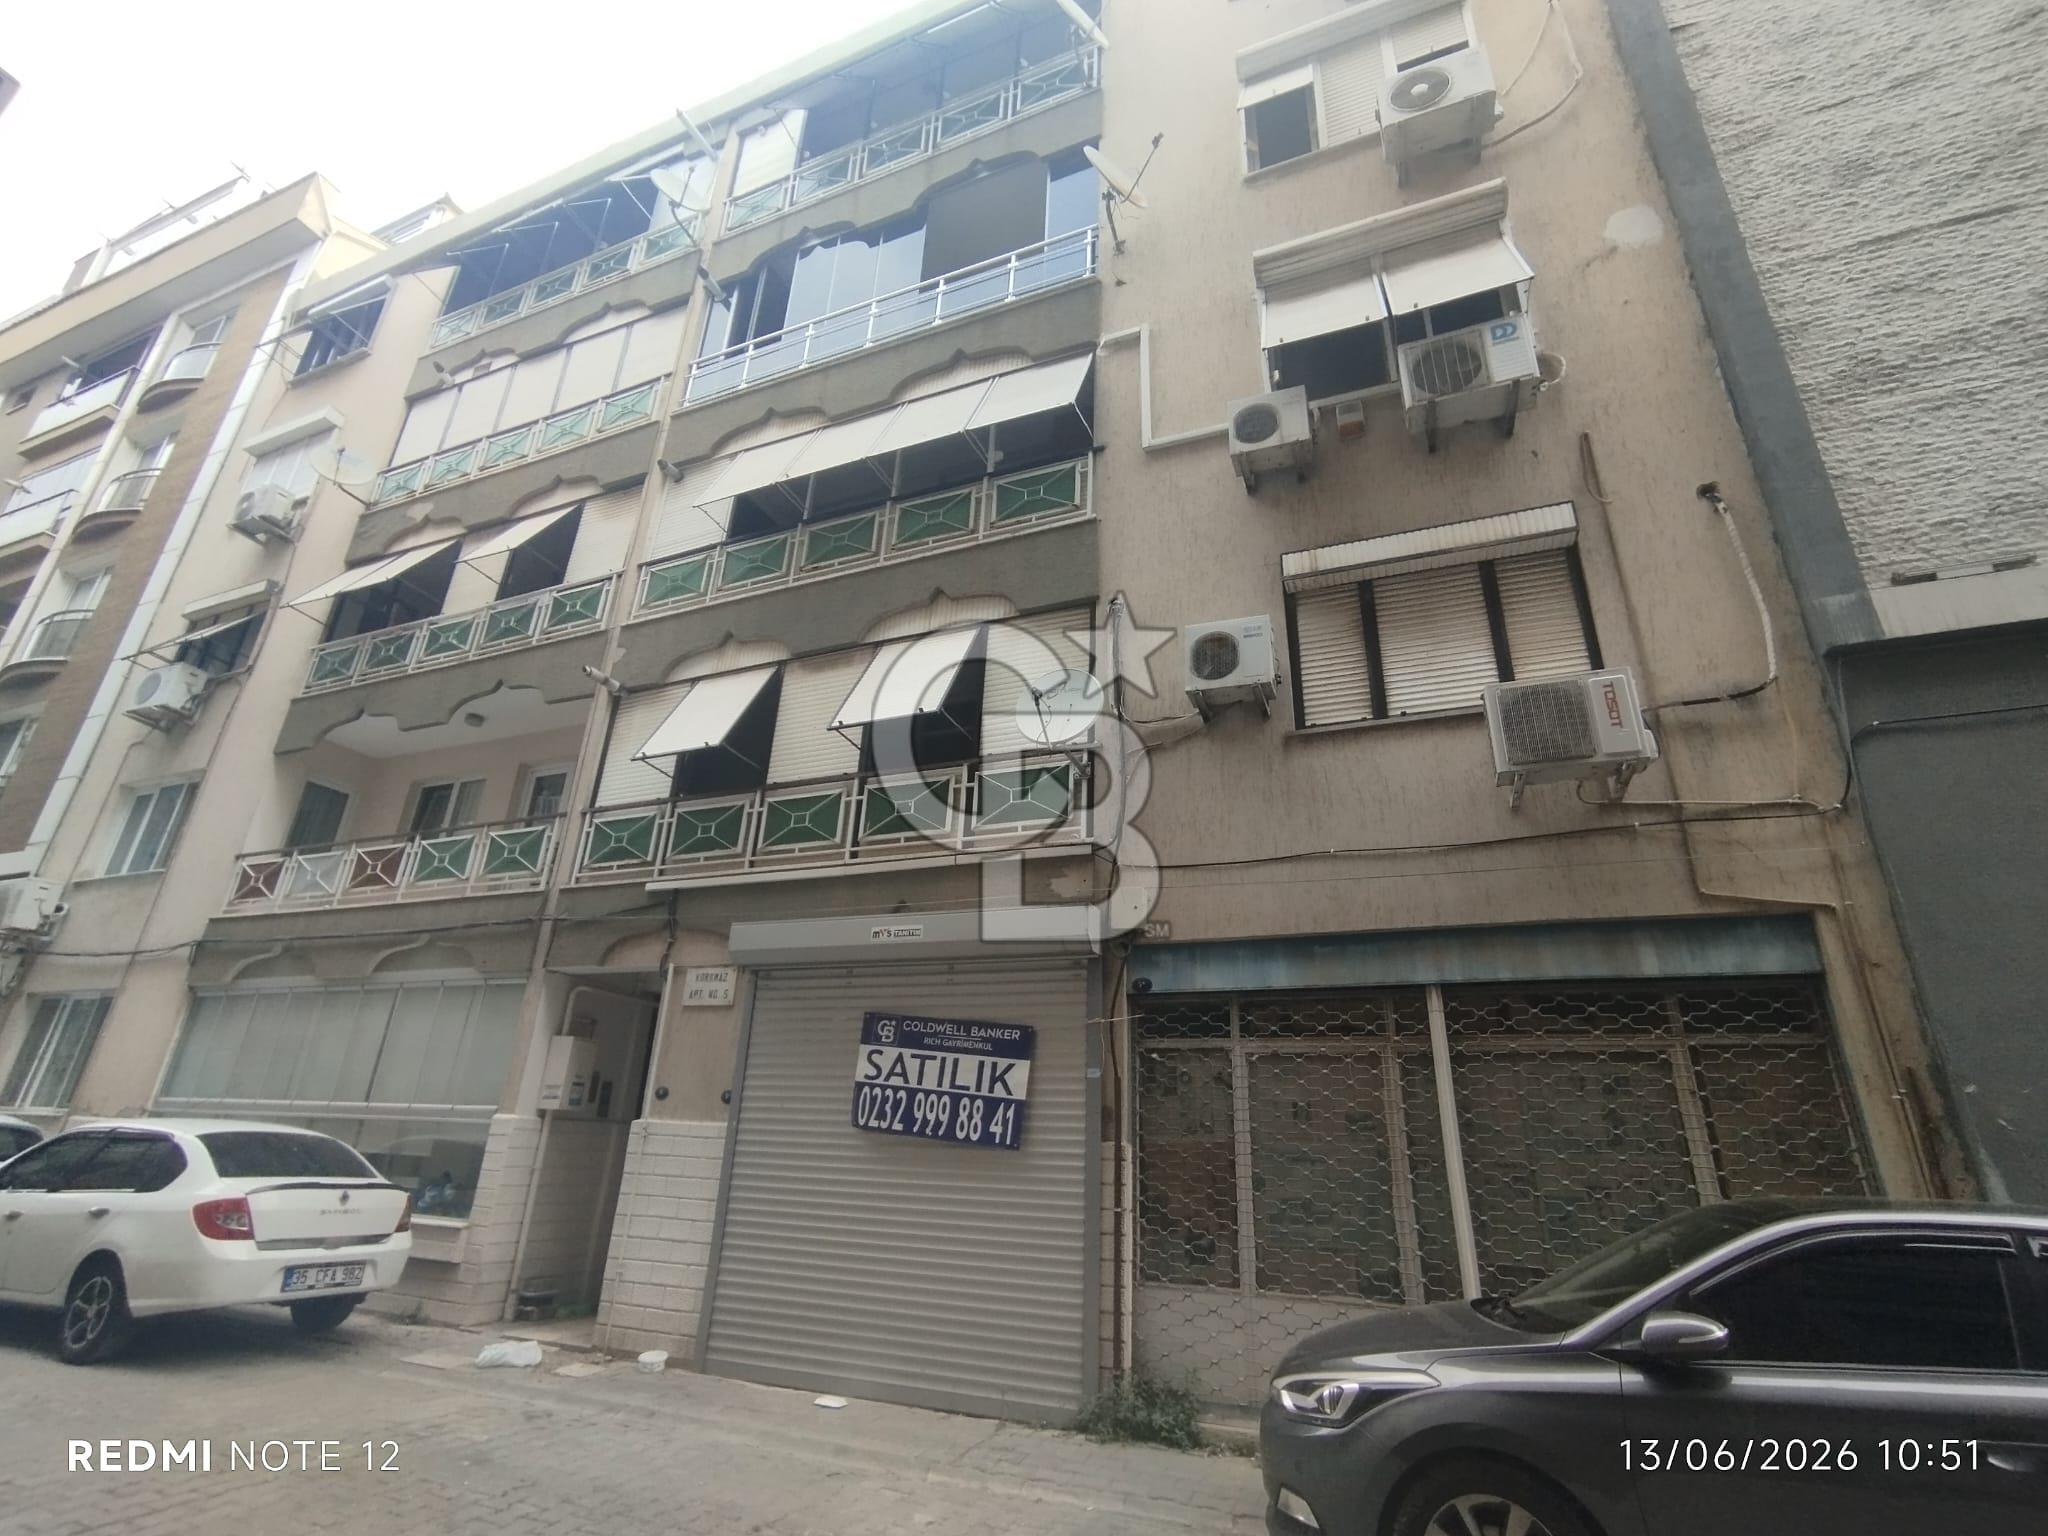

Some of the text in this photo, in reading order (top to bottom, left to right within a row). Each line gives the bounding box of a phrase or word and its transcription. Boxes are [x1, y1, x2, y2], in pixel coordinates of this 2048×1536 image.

[1602, 680, 1624, 729] TOSOT
[903, 1020, 1021, 1041] COLDWELL BANKER
[923, 1037, 941, 1047] RICH
[864, 1048, 1016, 1097] SATILIK
[857, 1085, 1016, 1145] 0232 999 88 41
[292, 1269, 308, 1285] 35
